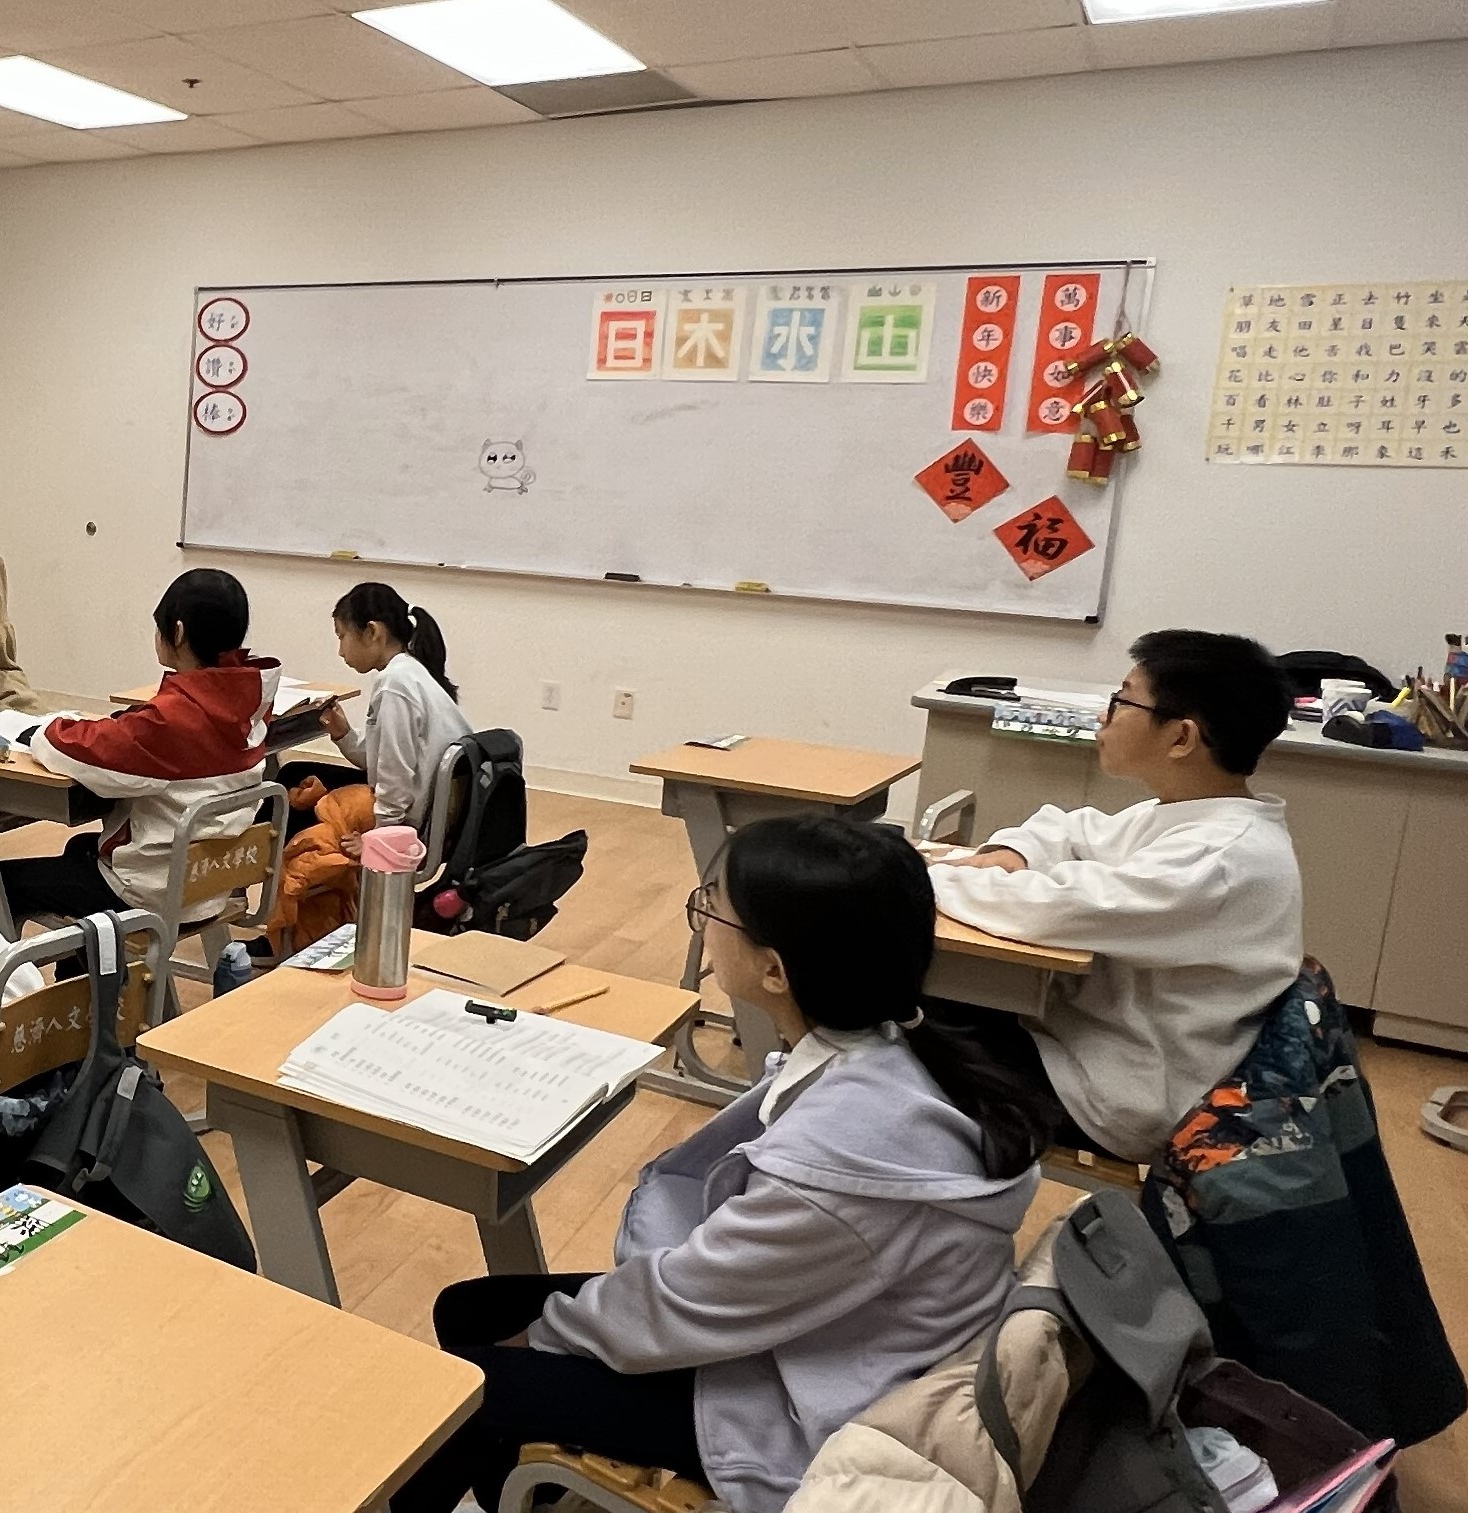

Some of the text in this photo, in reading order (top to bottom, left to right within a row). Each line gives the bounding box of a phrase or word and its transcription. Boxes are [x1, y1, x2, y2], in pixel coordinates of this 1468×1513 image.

[605, 320, 647, 368] 日
[676, 312, 726, 367] 木
[770, 310, 816, 372] 水
[857, 314, 918, 366] 山
[969, 289, 1002, 421] 新年快樂
[1015, 512, 1069, 561] 福
